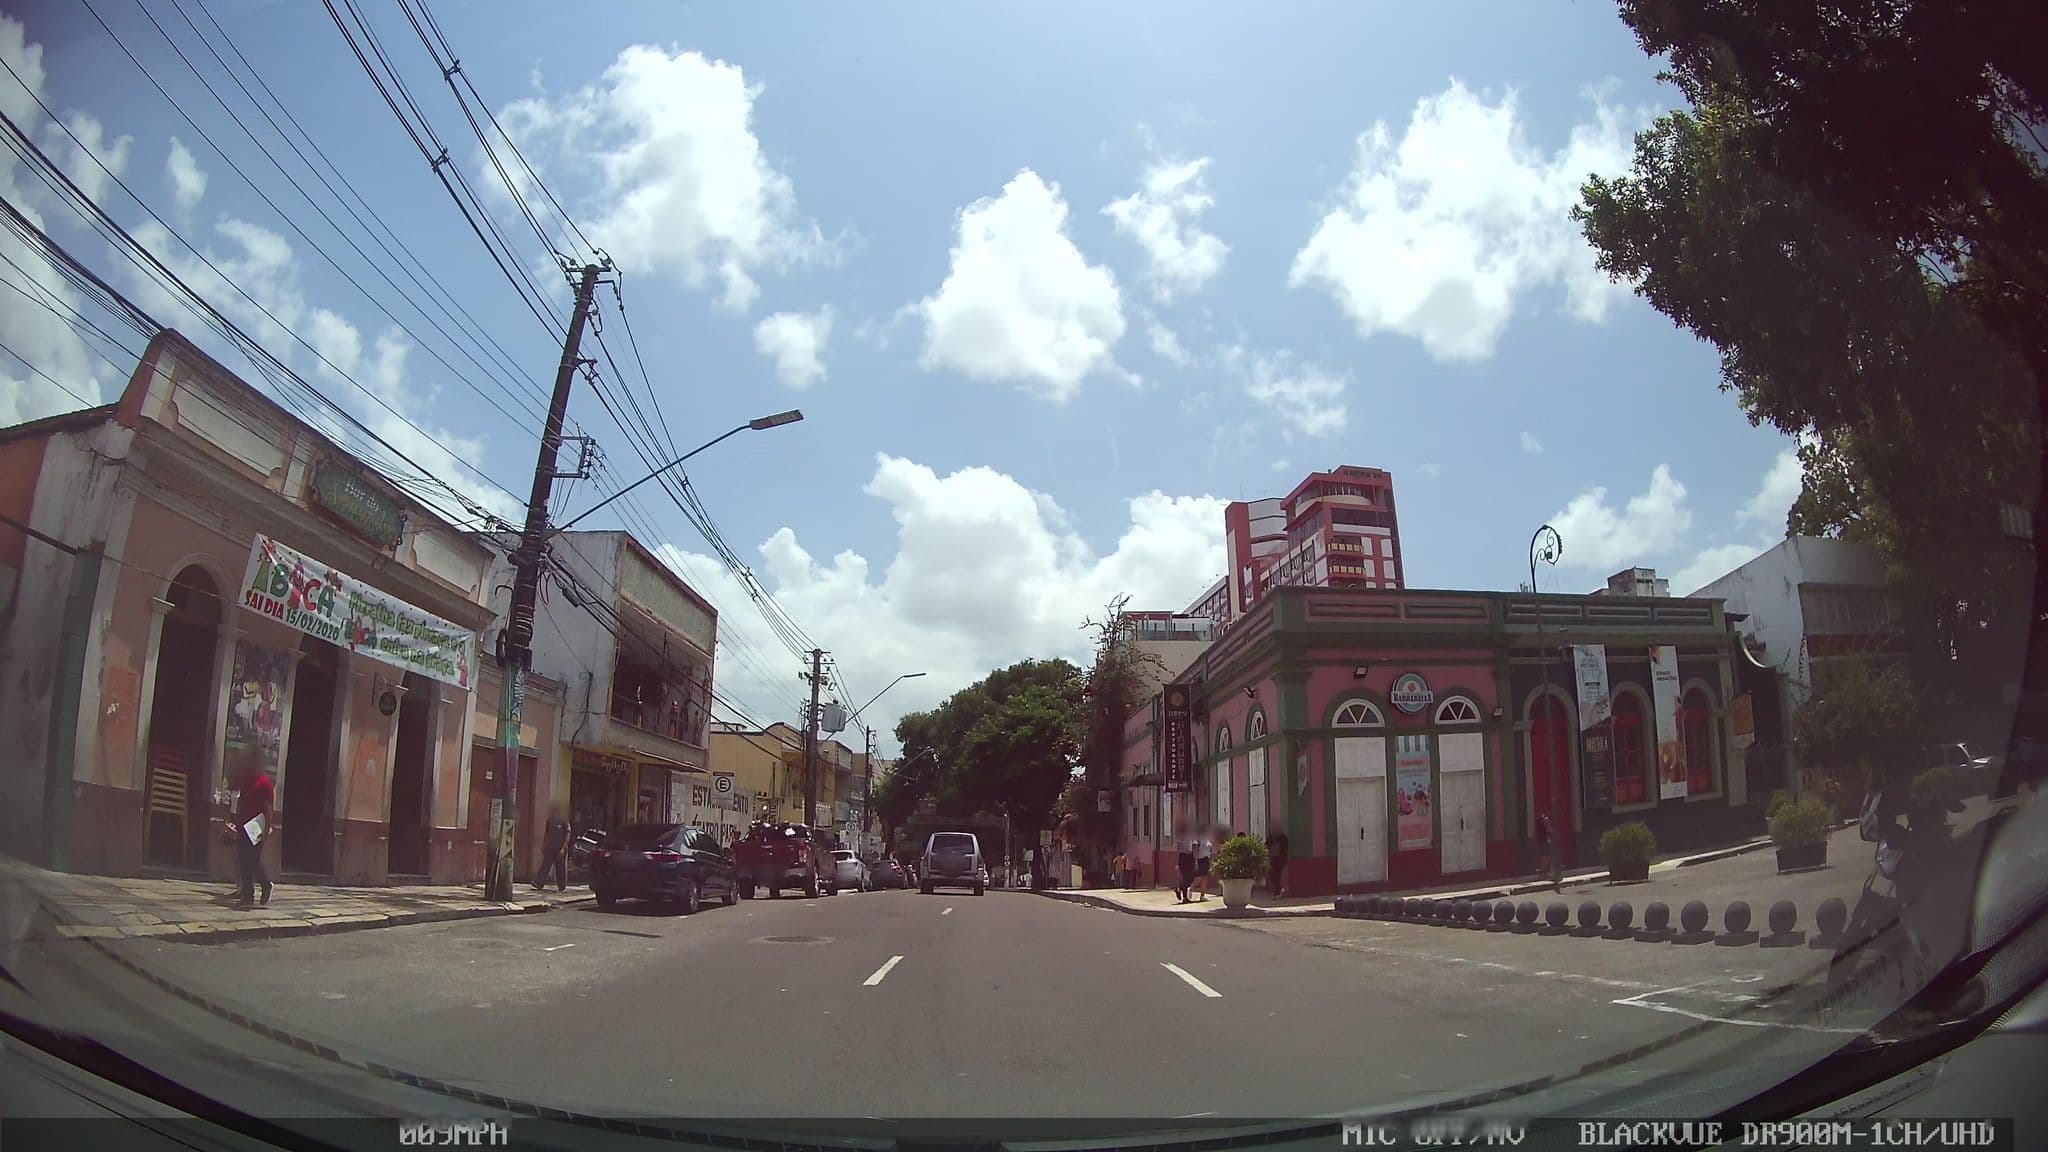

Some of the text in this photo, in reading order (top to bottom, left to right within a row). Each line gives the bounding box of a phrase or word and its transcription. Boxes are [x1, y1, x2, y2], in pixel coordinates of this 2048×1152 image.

[270, 563, 335, 618] BICA
[244, 590, 340, 641] SAI DIA 15/02/2020
[692, 784, 749, 814] ESTAENTO
[719, 779, 728, 790] E
